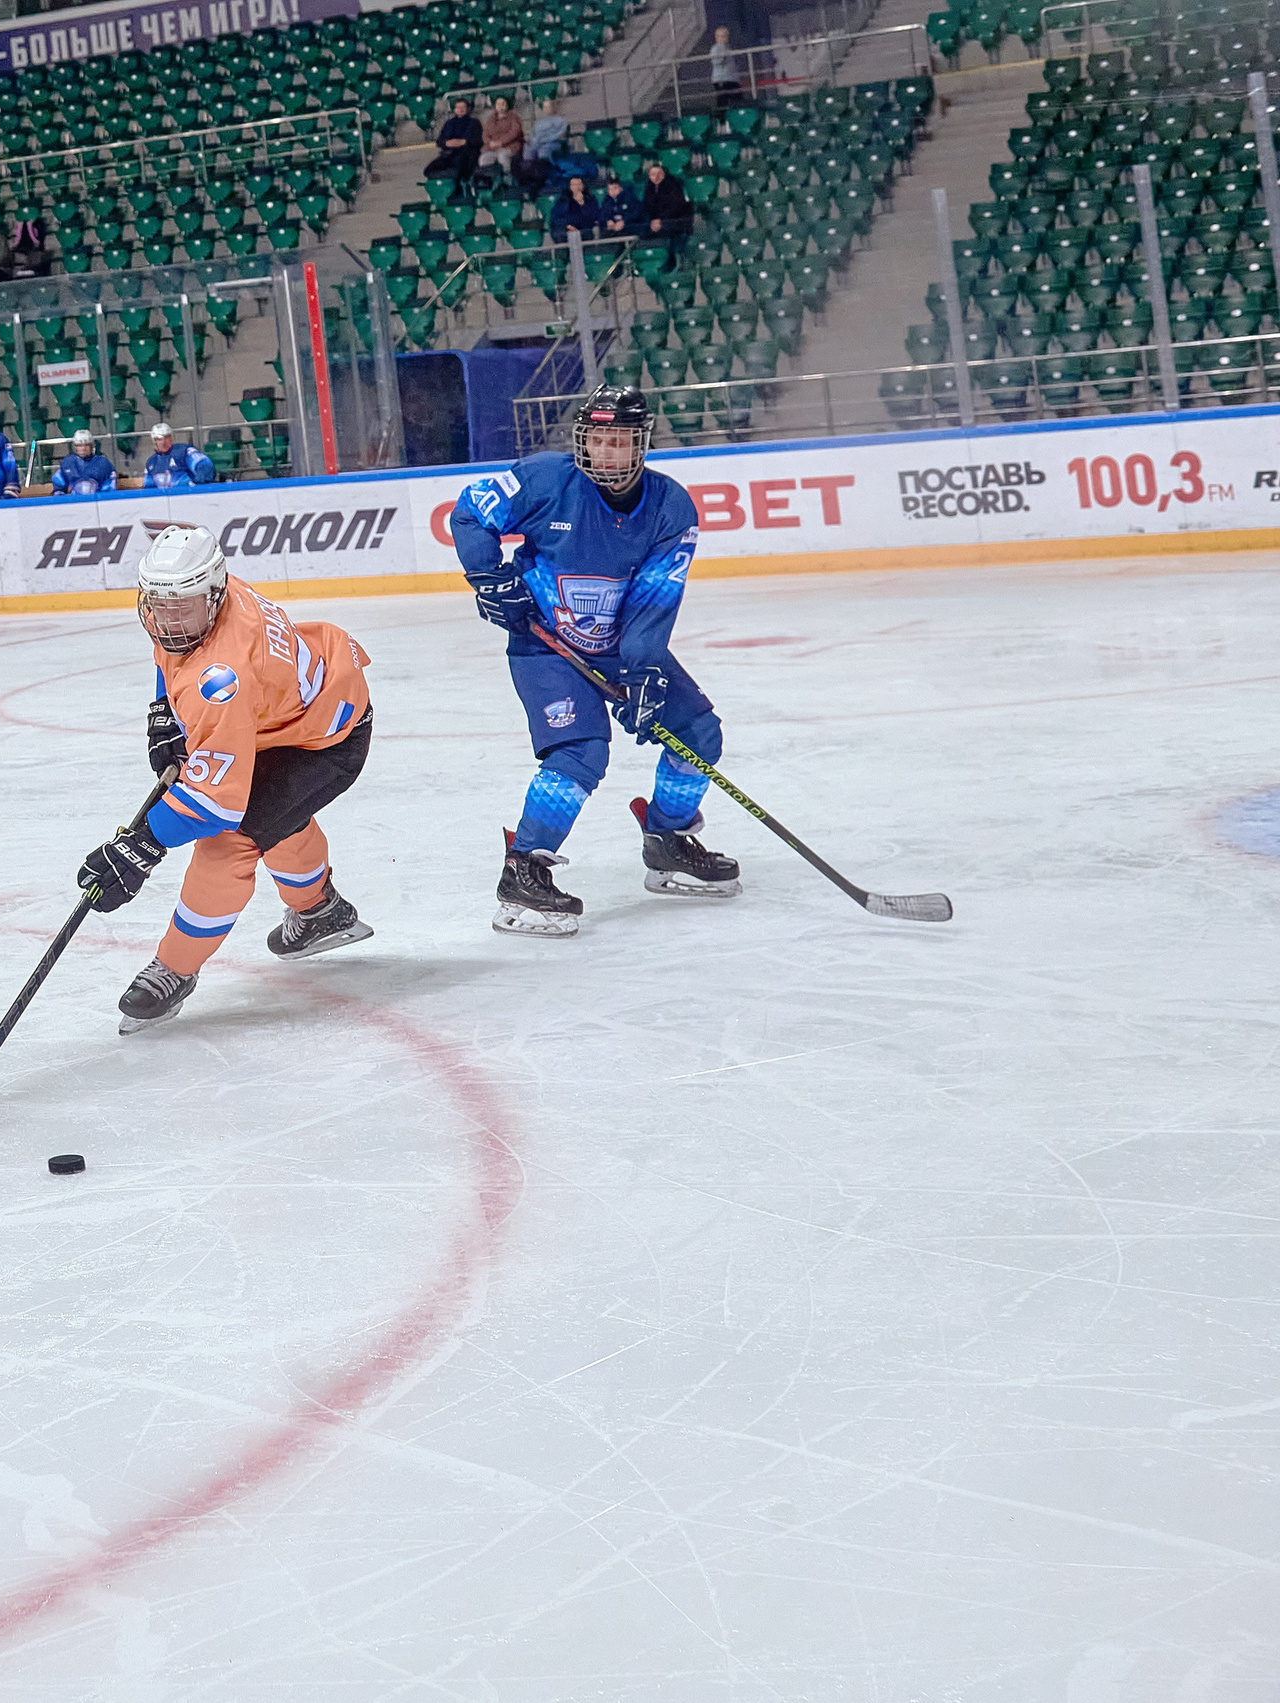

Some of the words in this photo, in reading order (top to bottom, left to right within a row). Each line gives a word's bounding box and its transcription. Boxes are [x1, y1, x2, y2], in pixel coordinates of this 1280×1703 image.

[140, 6, 202, 45] ЧЕМ
[897, 462, 1046, 494] ПОСТАВЬ
[1067, 450, 1206, 513] 100,3
[1207, 483, 1236, 502] FM
[219, 507, 398, 557] СОКОЛ!
[185, 749, 235, 786] 57
